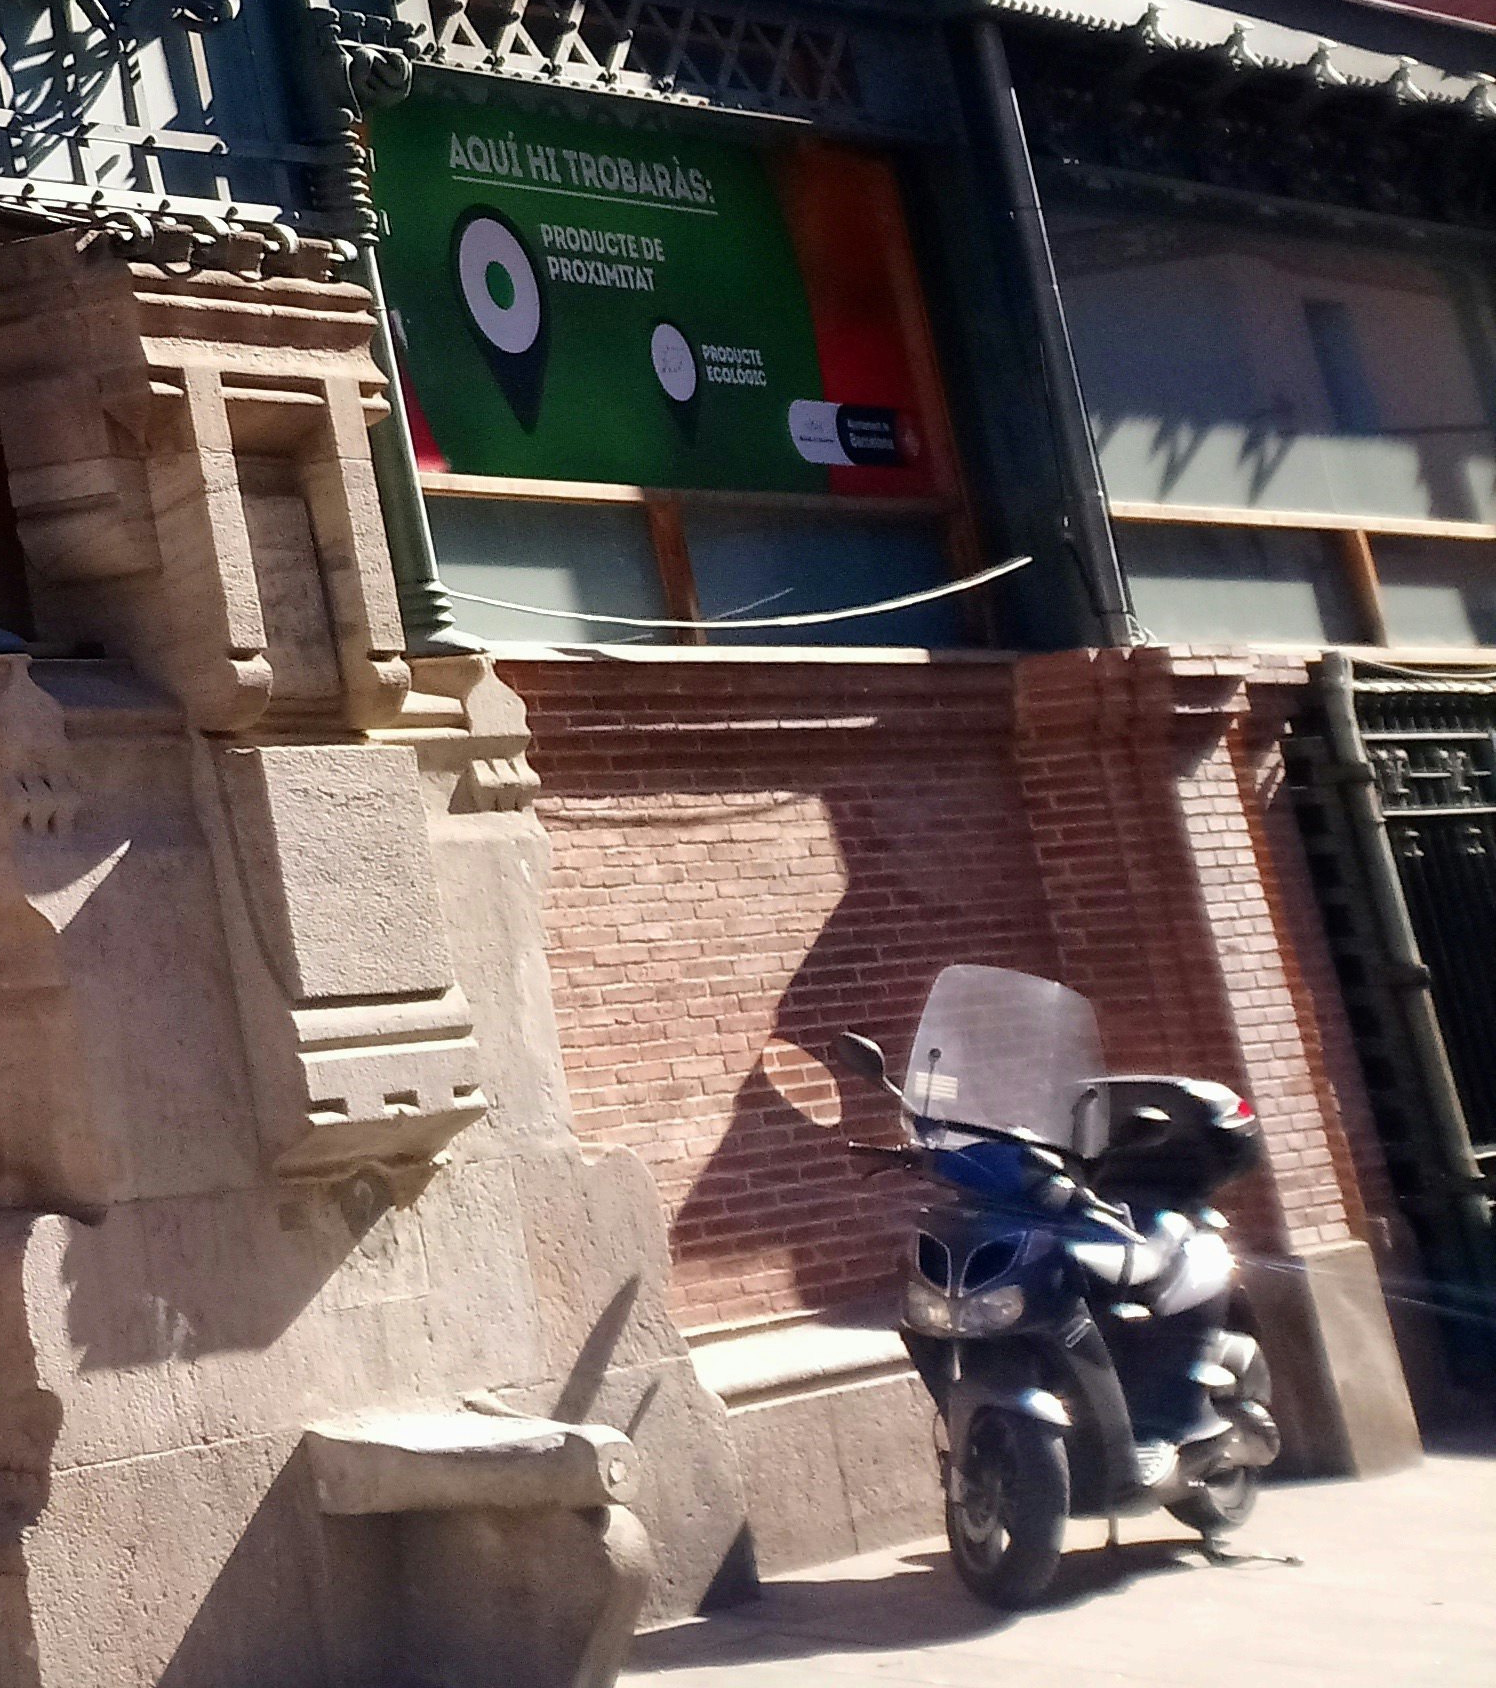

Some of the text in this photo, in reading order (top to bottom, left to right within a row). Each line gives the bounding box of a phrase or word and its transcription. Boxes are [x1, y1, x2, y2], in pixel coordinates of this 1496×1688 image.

[525, 144, 562, 184] HI
[540, 223, 665, 261] PRODUCTE DE
[547, 256, 655, 291] PROXIMITAT
[701, 344, 764, 366] PRODUCTE
